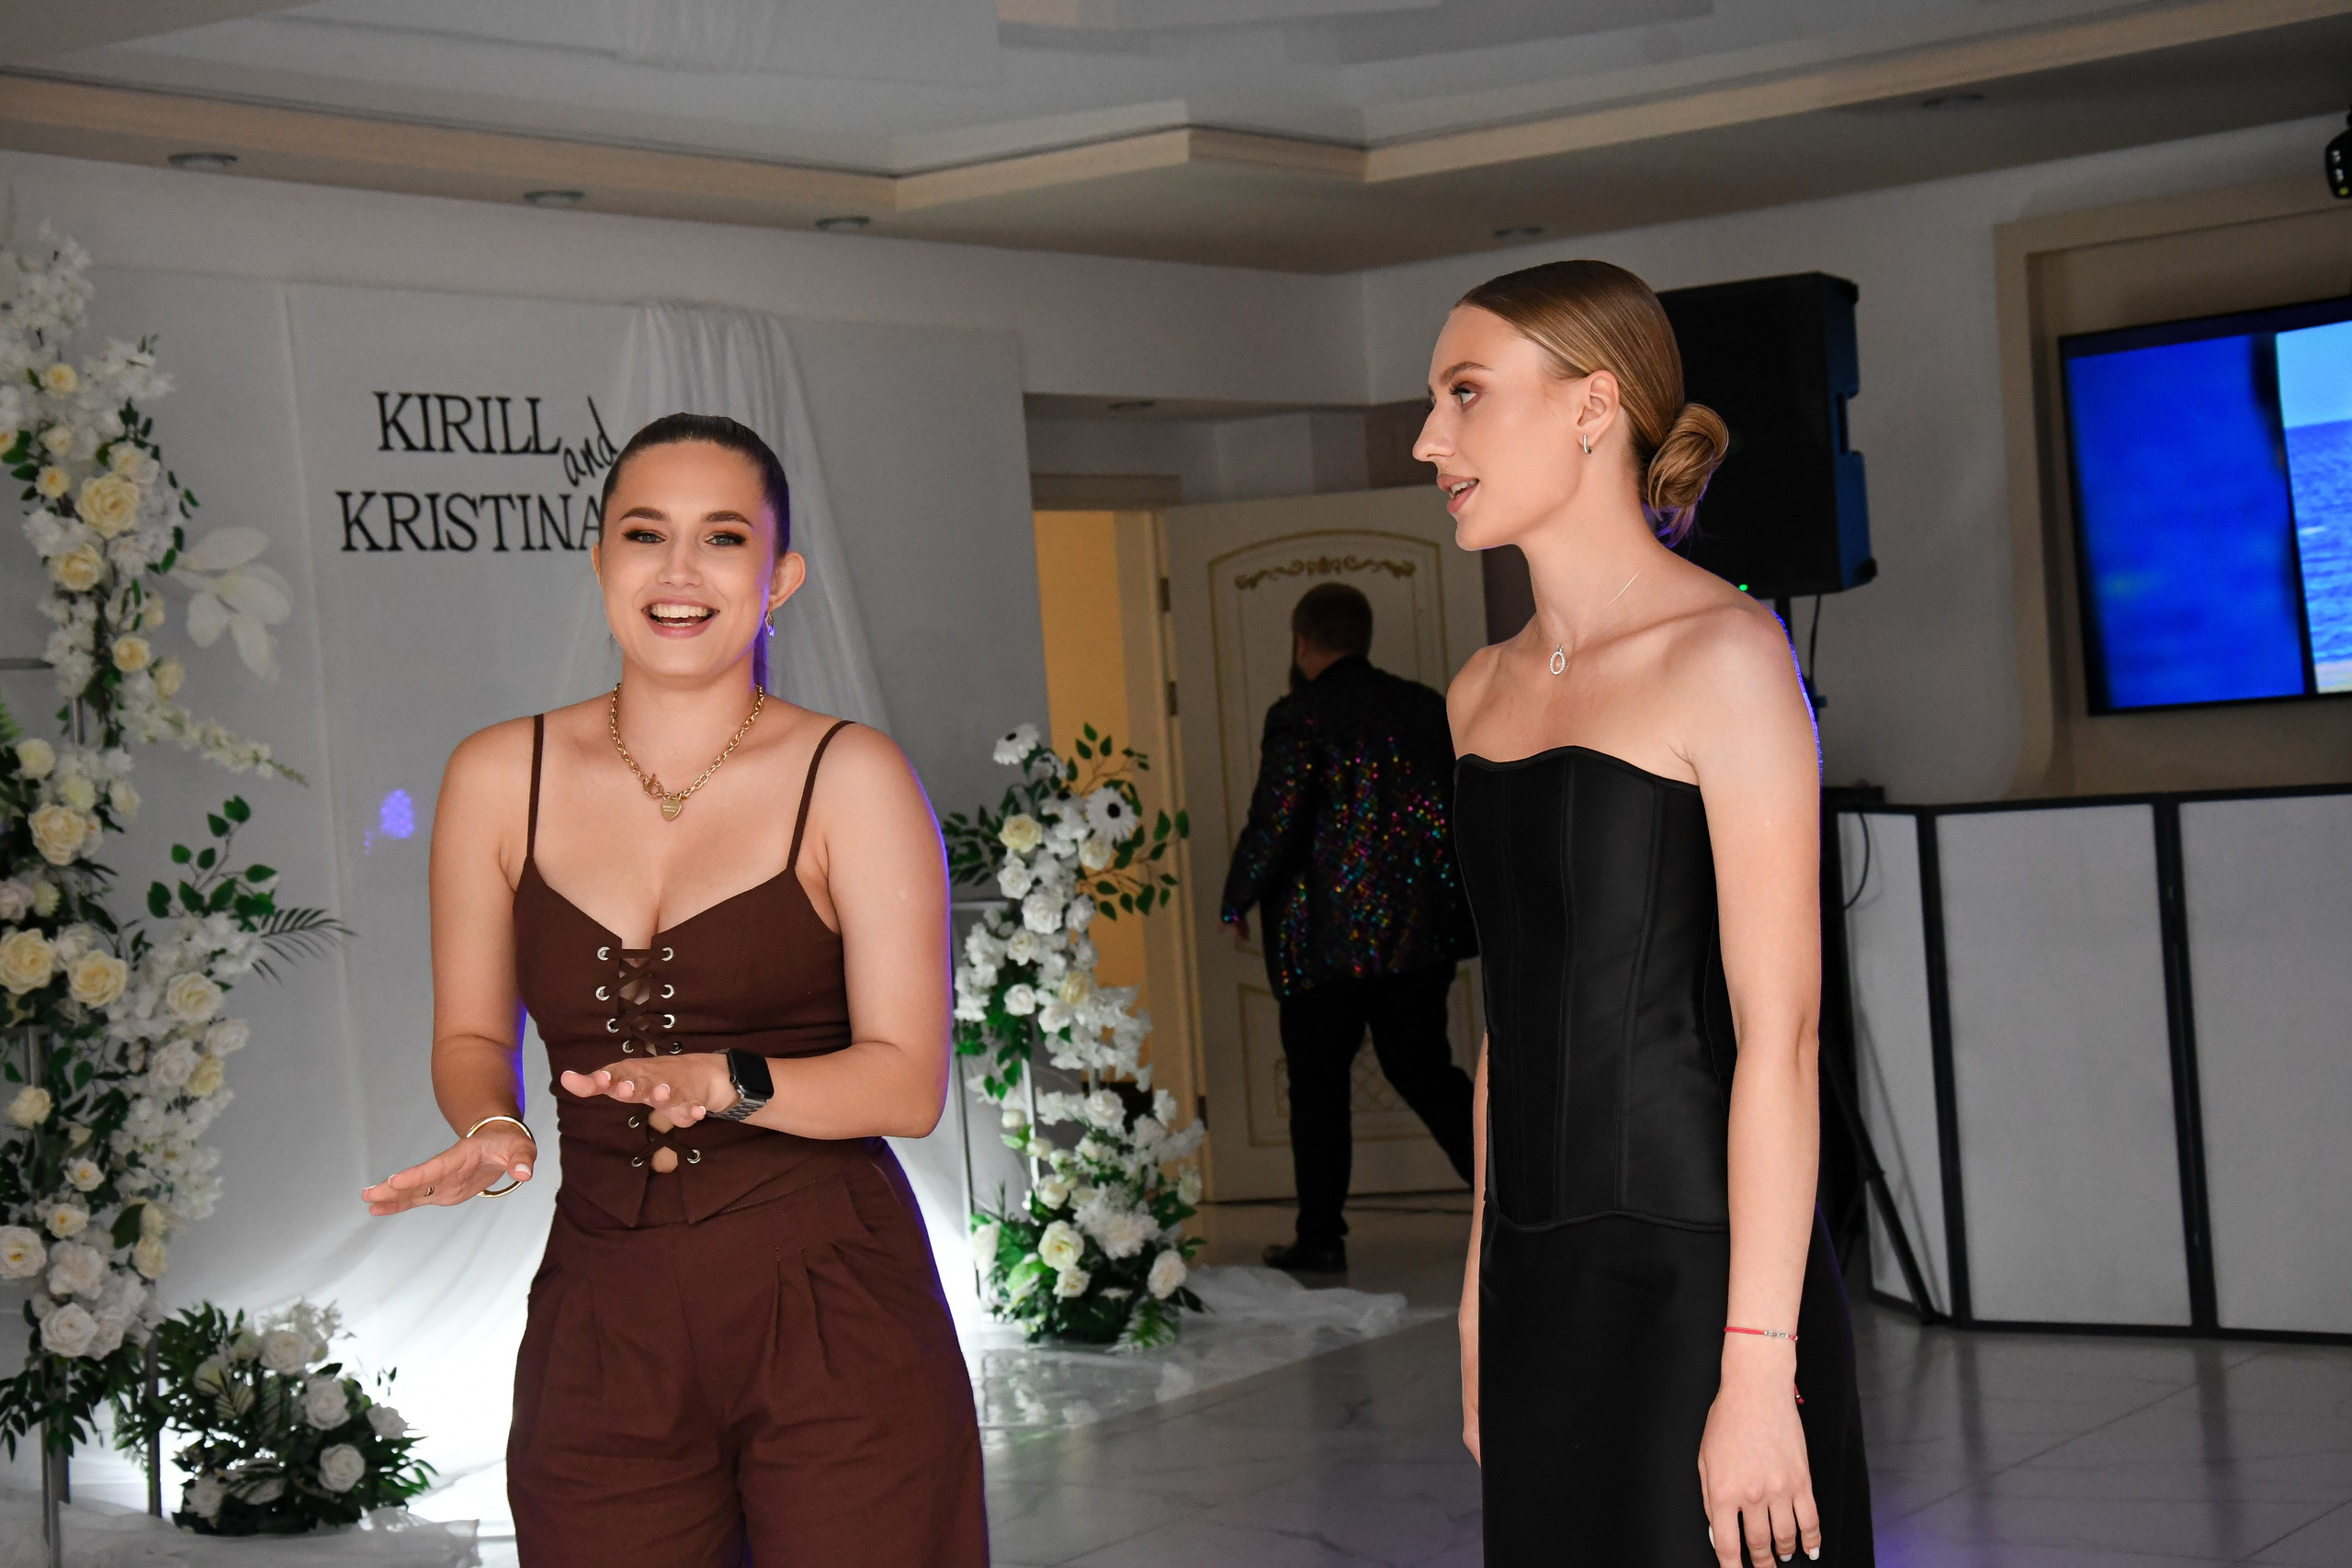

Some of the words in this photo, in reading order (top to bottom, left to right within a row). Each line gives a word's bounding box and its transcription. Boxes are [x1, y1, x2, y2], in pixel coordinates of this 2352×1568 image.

[372, 391, 562, 456] KIRILL
[563, 395, 619, 487] and
[334, 491, 600, 552] KRISTINA
